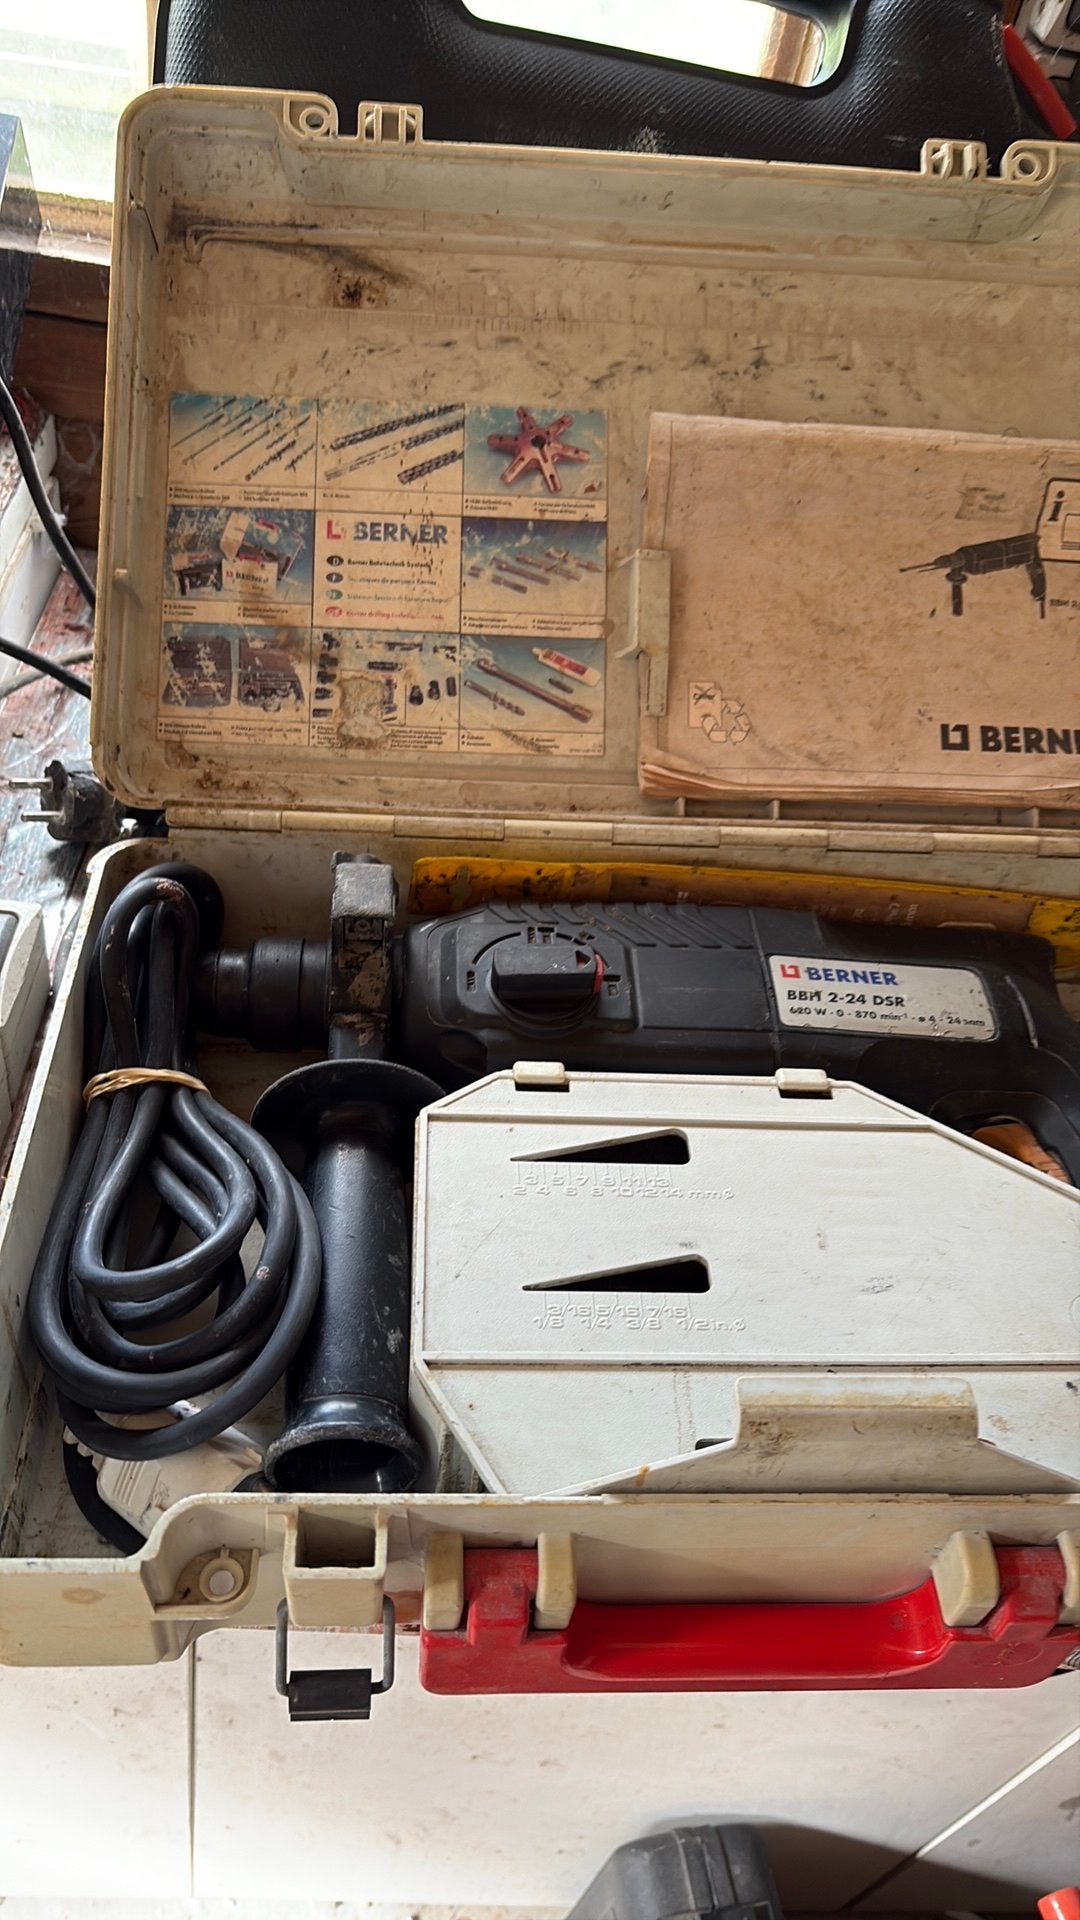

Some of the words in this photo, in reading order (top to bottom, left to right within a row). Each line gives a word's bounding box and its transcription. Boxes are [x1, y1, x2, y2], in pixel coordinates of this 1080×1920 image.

[353, 522, 448, 544] BERNER
[805, 966, 898, 986] BERNER
[787, 990, 822, 1002] BBH
[828, 992, 867, 1005] 2-24
[873, 995, 905, 1008] DSR
[814, 1008, 827, 1016] W
[525, 1175, 539, 1185] 3
[551, 1176, 565, 1186] 5
[577, 1176, 589, 1186] 7
[602, 1176, 616, 1187] 9
[513, 1186, 528, 1196] 2
[535, 1186, 551, 1197] 4
[565, 1187, 578, 1197] 6
[592, 1187, 604, 1197] 8
[547, 1303, 592, 1317] 3/16
[597, 1304, 640, 1318] 5/16
[646, 1305, 687, 1319] 7/16
[532, 1316, 566, 1330] 1/8
[580, 1316, 612, 1330] 1/4
[625, 1317, 661, 1331] 3/8
